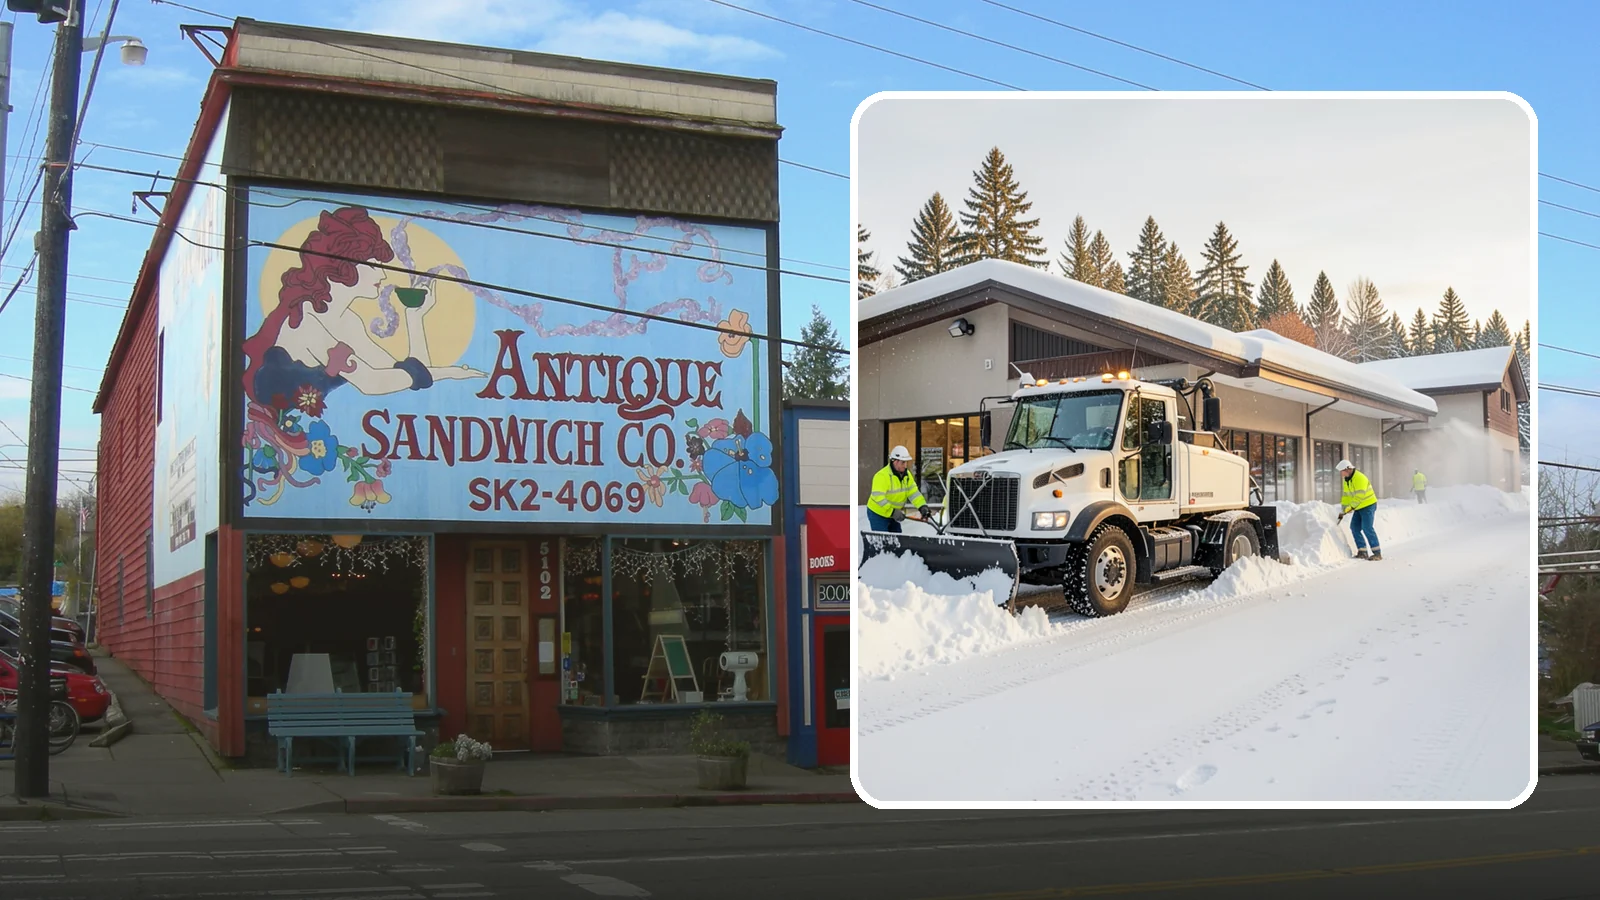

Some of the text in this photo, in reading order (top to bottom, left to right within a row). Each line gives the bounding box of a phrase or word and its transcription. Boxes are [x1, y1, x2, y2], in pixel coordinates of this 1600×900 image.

[361, 408, 686, 468] SANDWICH CO.
[468, 477, 646, 513] SK2-4069
[540, 541, 551, 600] 5102
[809, 555, 835, 569] BOOKS
